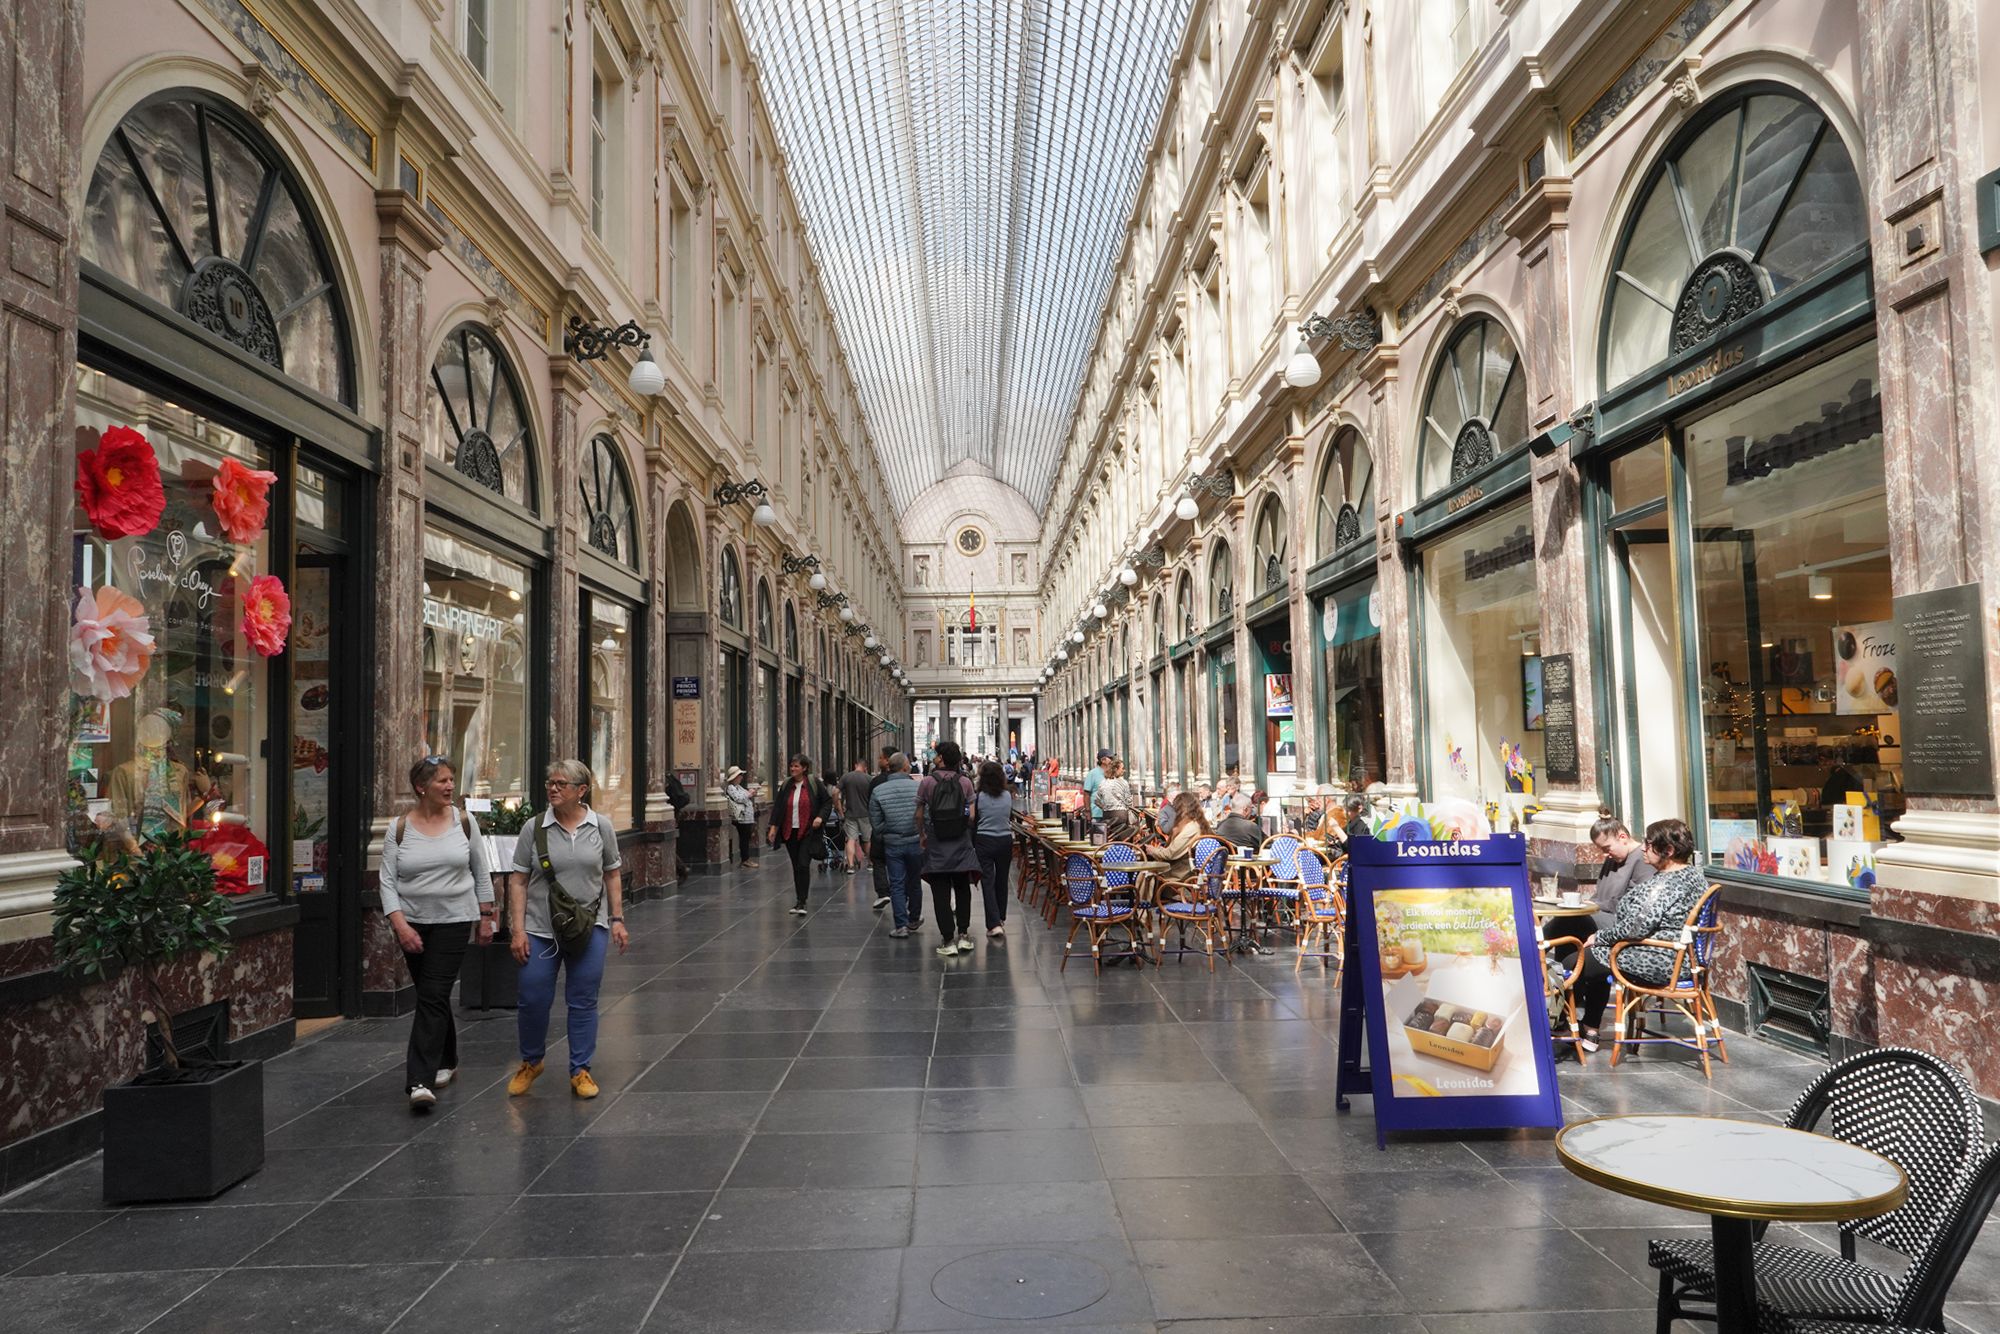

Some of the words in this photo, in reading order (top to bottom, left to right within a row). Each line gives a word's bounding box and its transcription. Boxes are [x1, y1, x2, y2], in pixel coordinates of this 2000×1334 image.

[1665, 344, 1745, 398] Leonidas
[1396, 841, 1481, 857] Leonidas
[1406, 907, 1418, 917] Elk
[1422, 907, 1443, 916] mooi
[1446, 907, 1483, 916] moment
[1397, 920, 1433, 930] verdient
[1435, 922, 1451, 930] een
[1429, 1041, 1465, 1056] Leonidas
[1436, 1076, 1495, 1089] Leonidas
